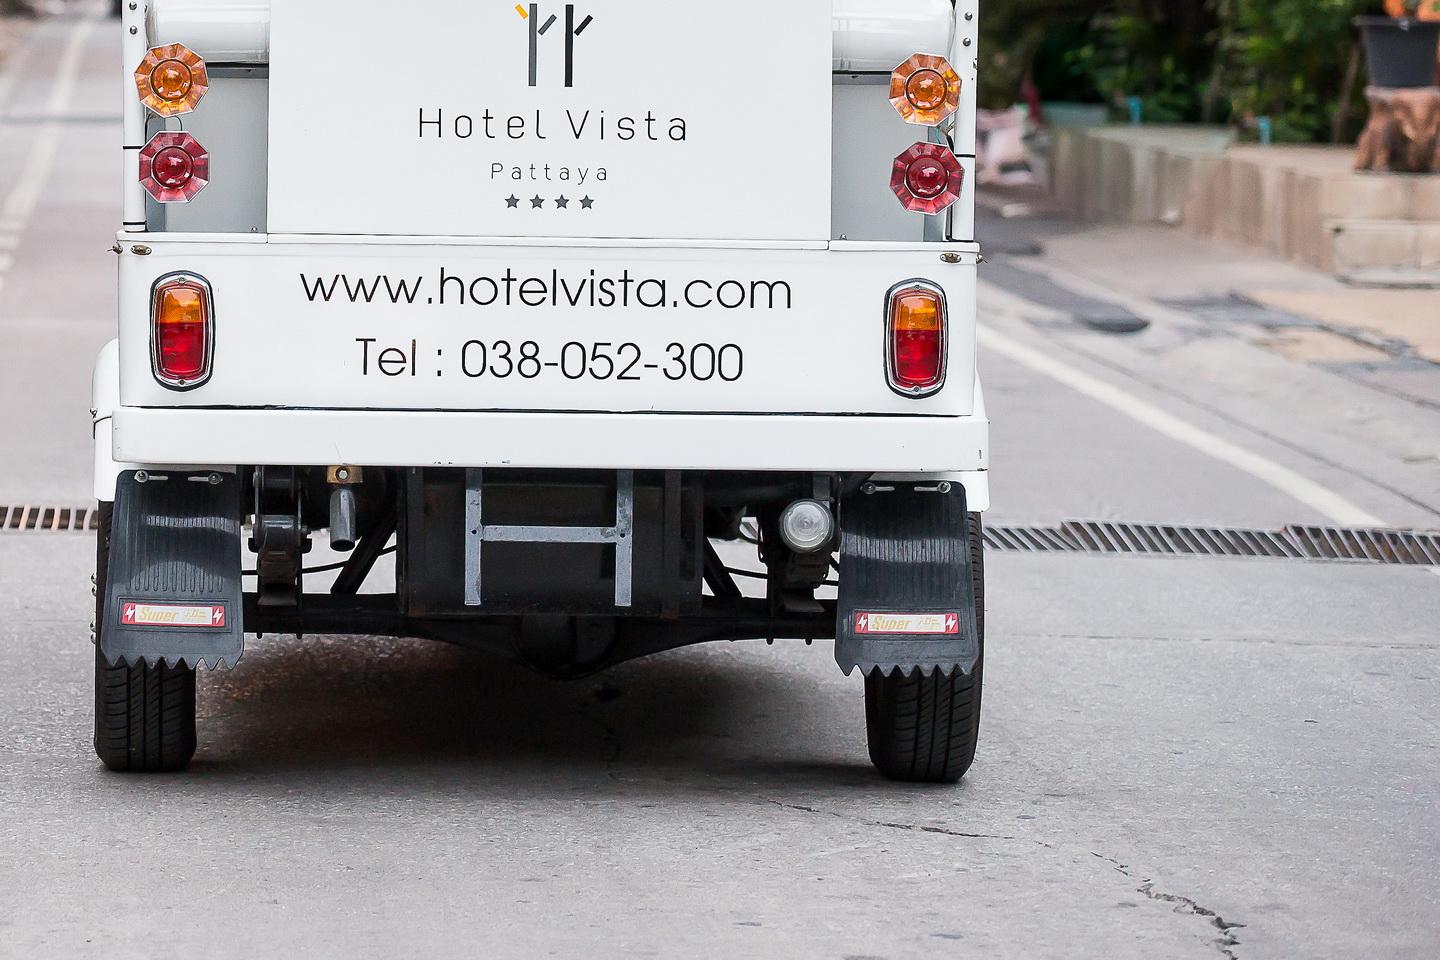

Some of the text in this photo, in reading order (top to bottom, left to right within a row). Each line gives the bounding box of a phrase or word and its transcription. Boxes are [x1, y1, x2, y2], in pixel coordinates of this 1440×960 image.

[418, 107, 687, 142] Hotel Vista
[490, 162, 608, 186] Pattaya
[299, 266, 792, 309] www.hotelvista.com
[355, 337, 417, 377] Tel
[461, 339, 744, 382] 038-052-300
